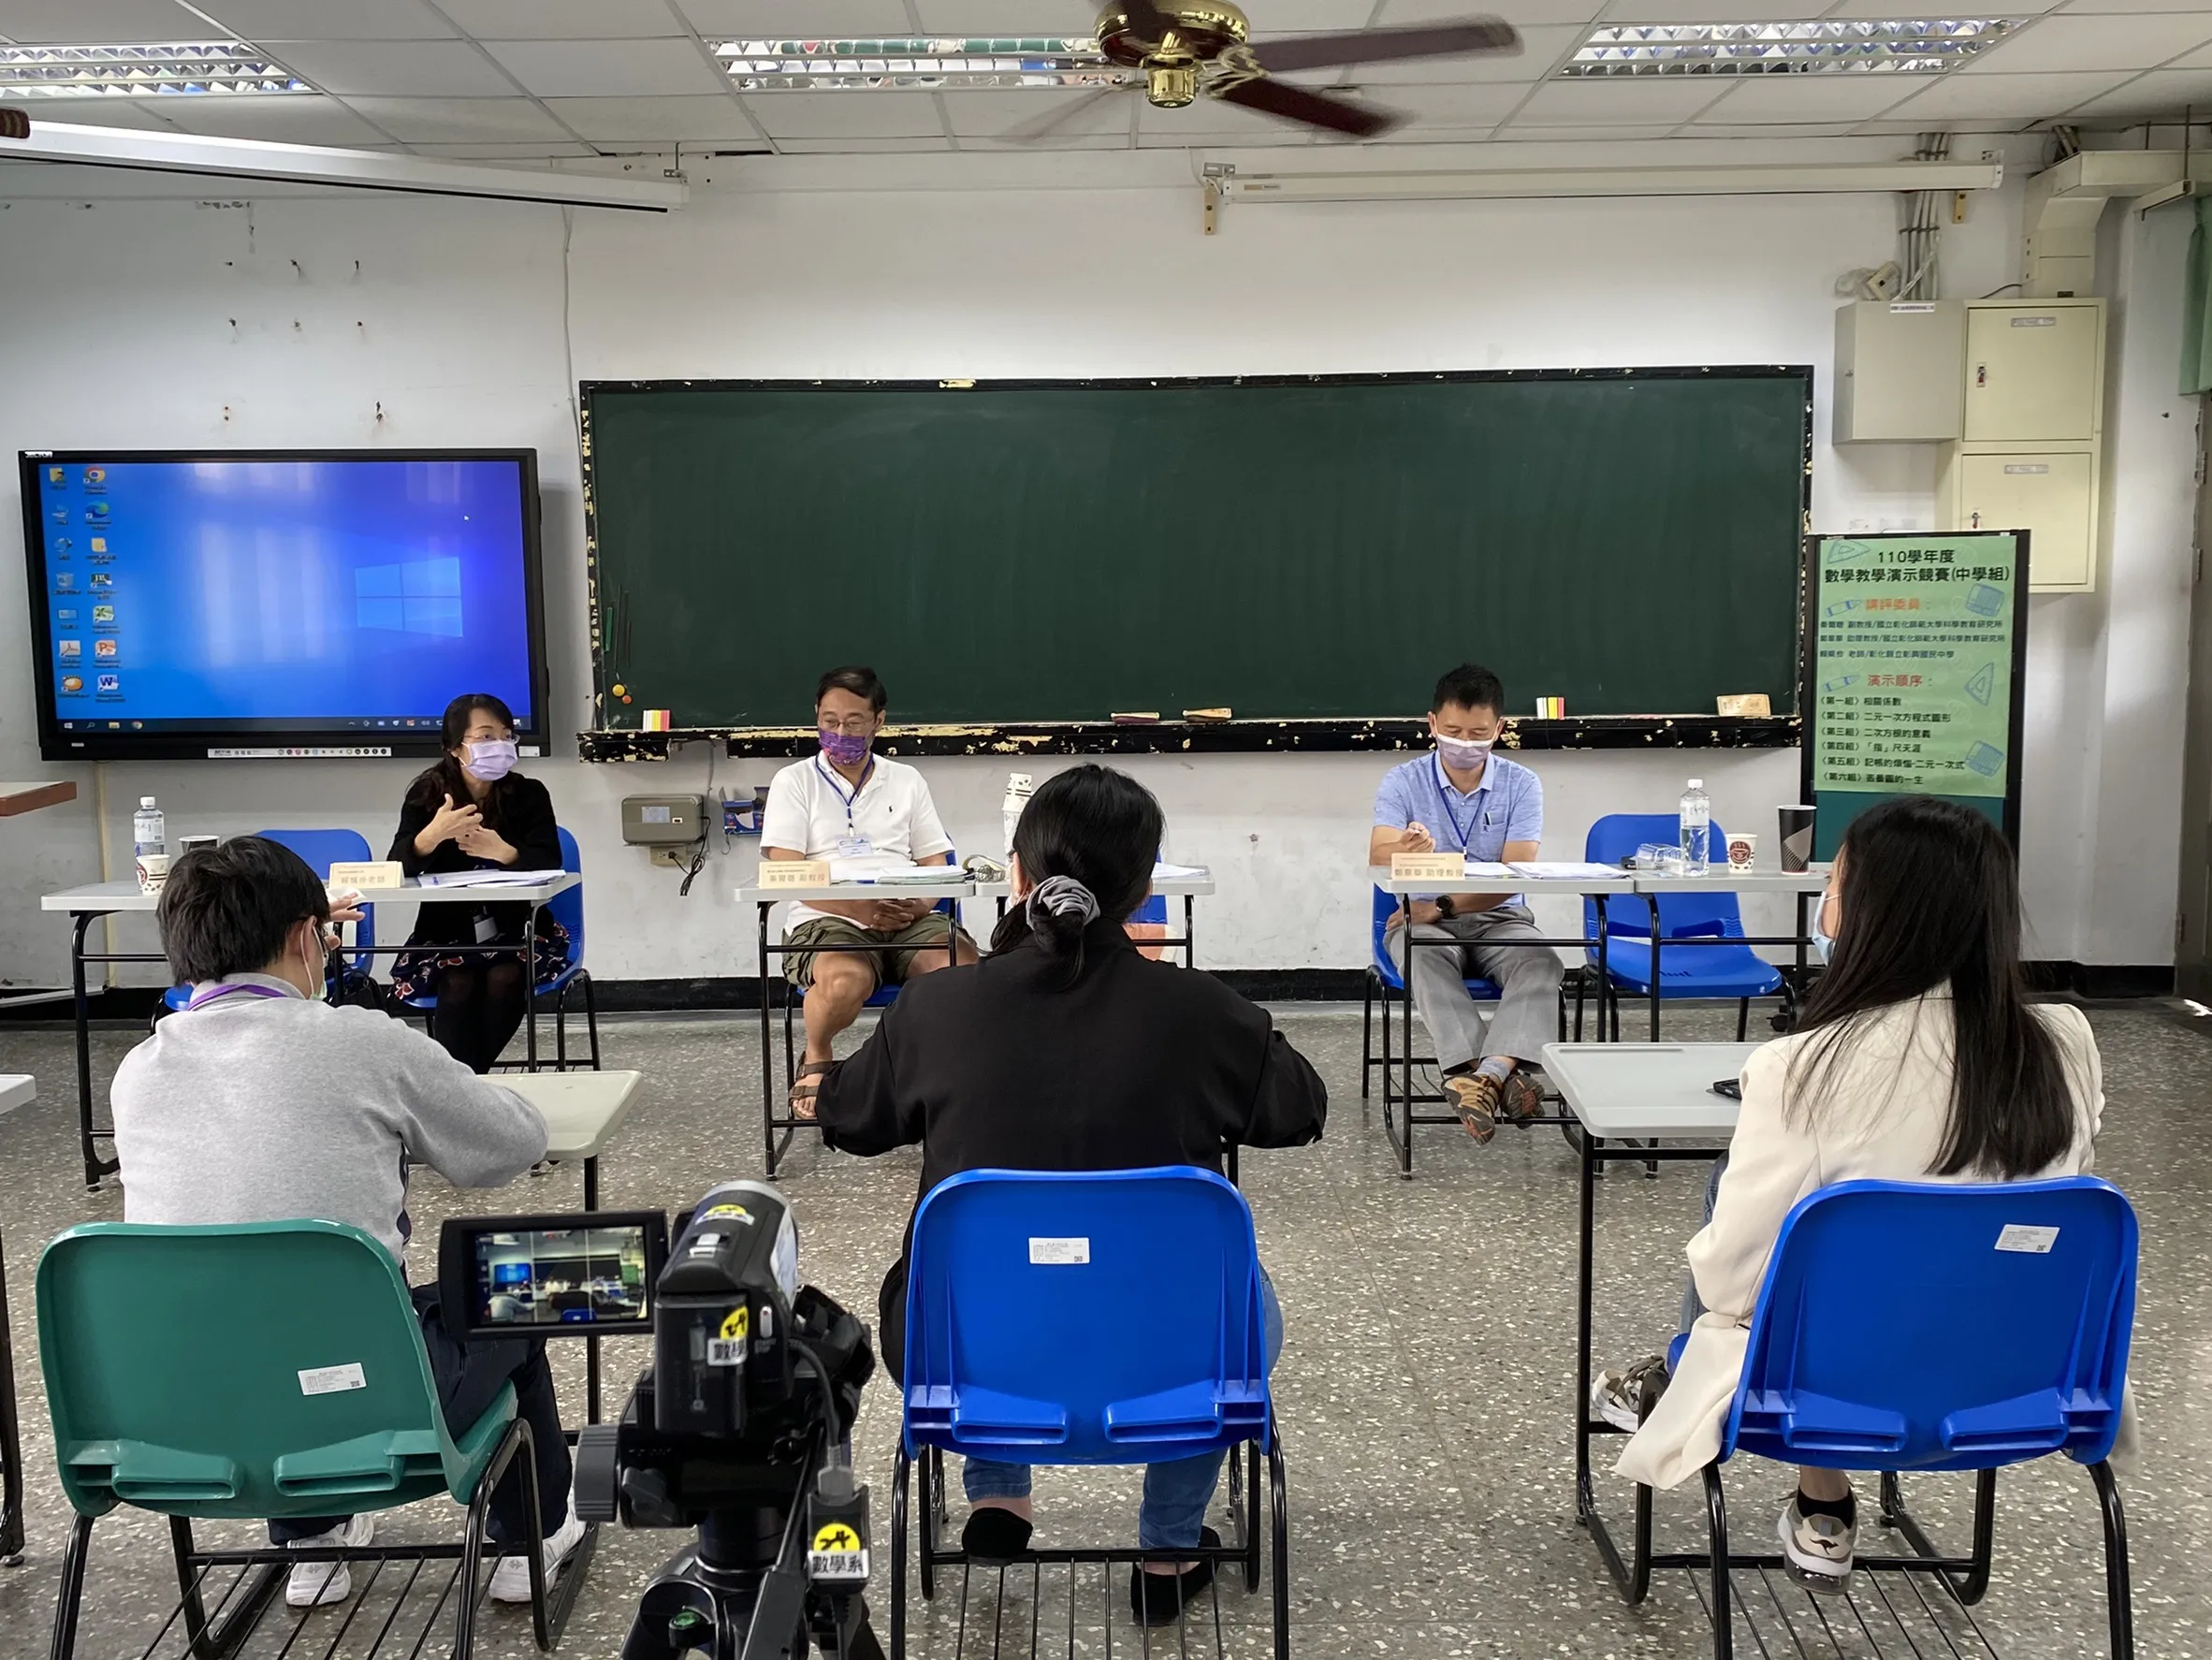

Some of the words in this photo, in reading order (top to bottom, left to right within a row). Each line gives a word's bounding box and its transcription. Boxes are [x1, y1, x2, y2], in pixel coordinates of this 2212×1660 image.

[1878, 549, 1956, 563] 110學年度
[1825, 565, 2010, 583] 數學教學演示競賽(中學組)
[812, 1555, 863, 1573] 數學系
